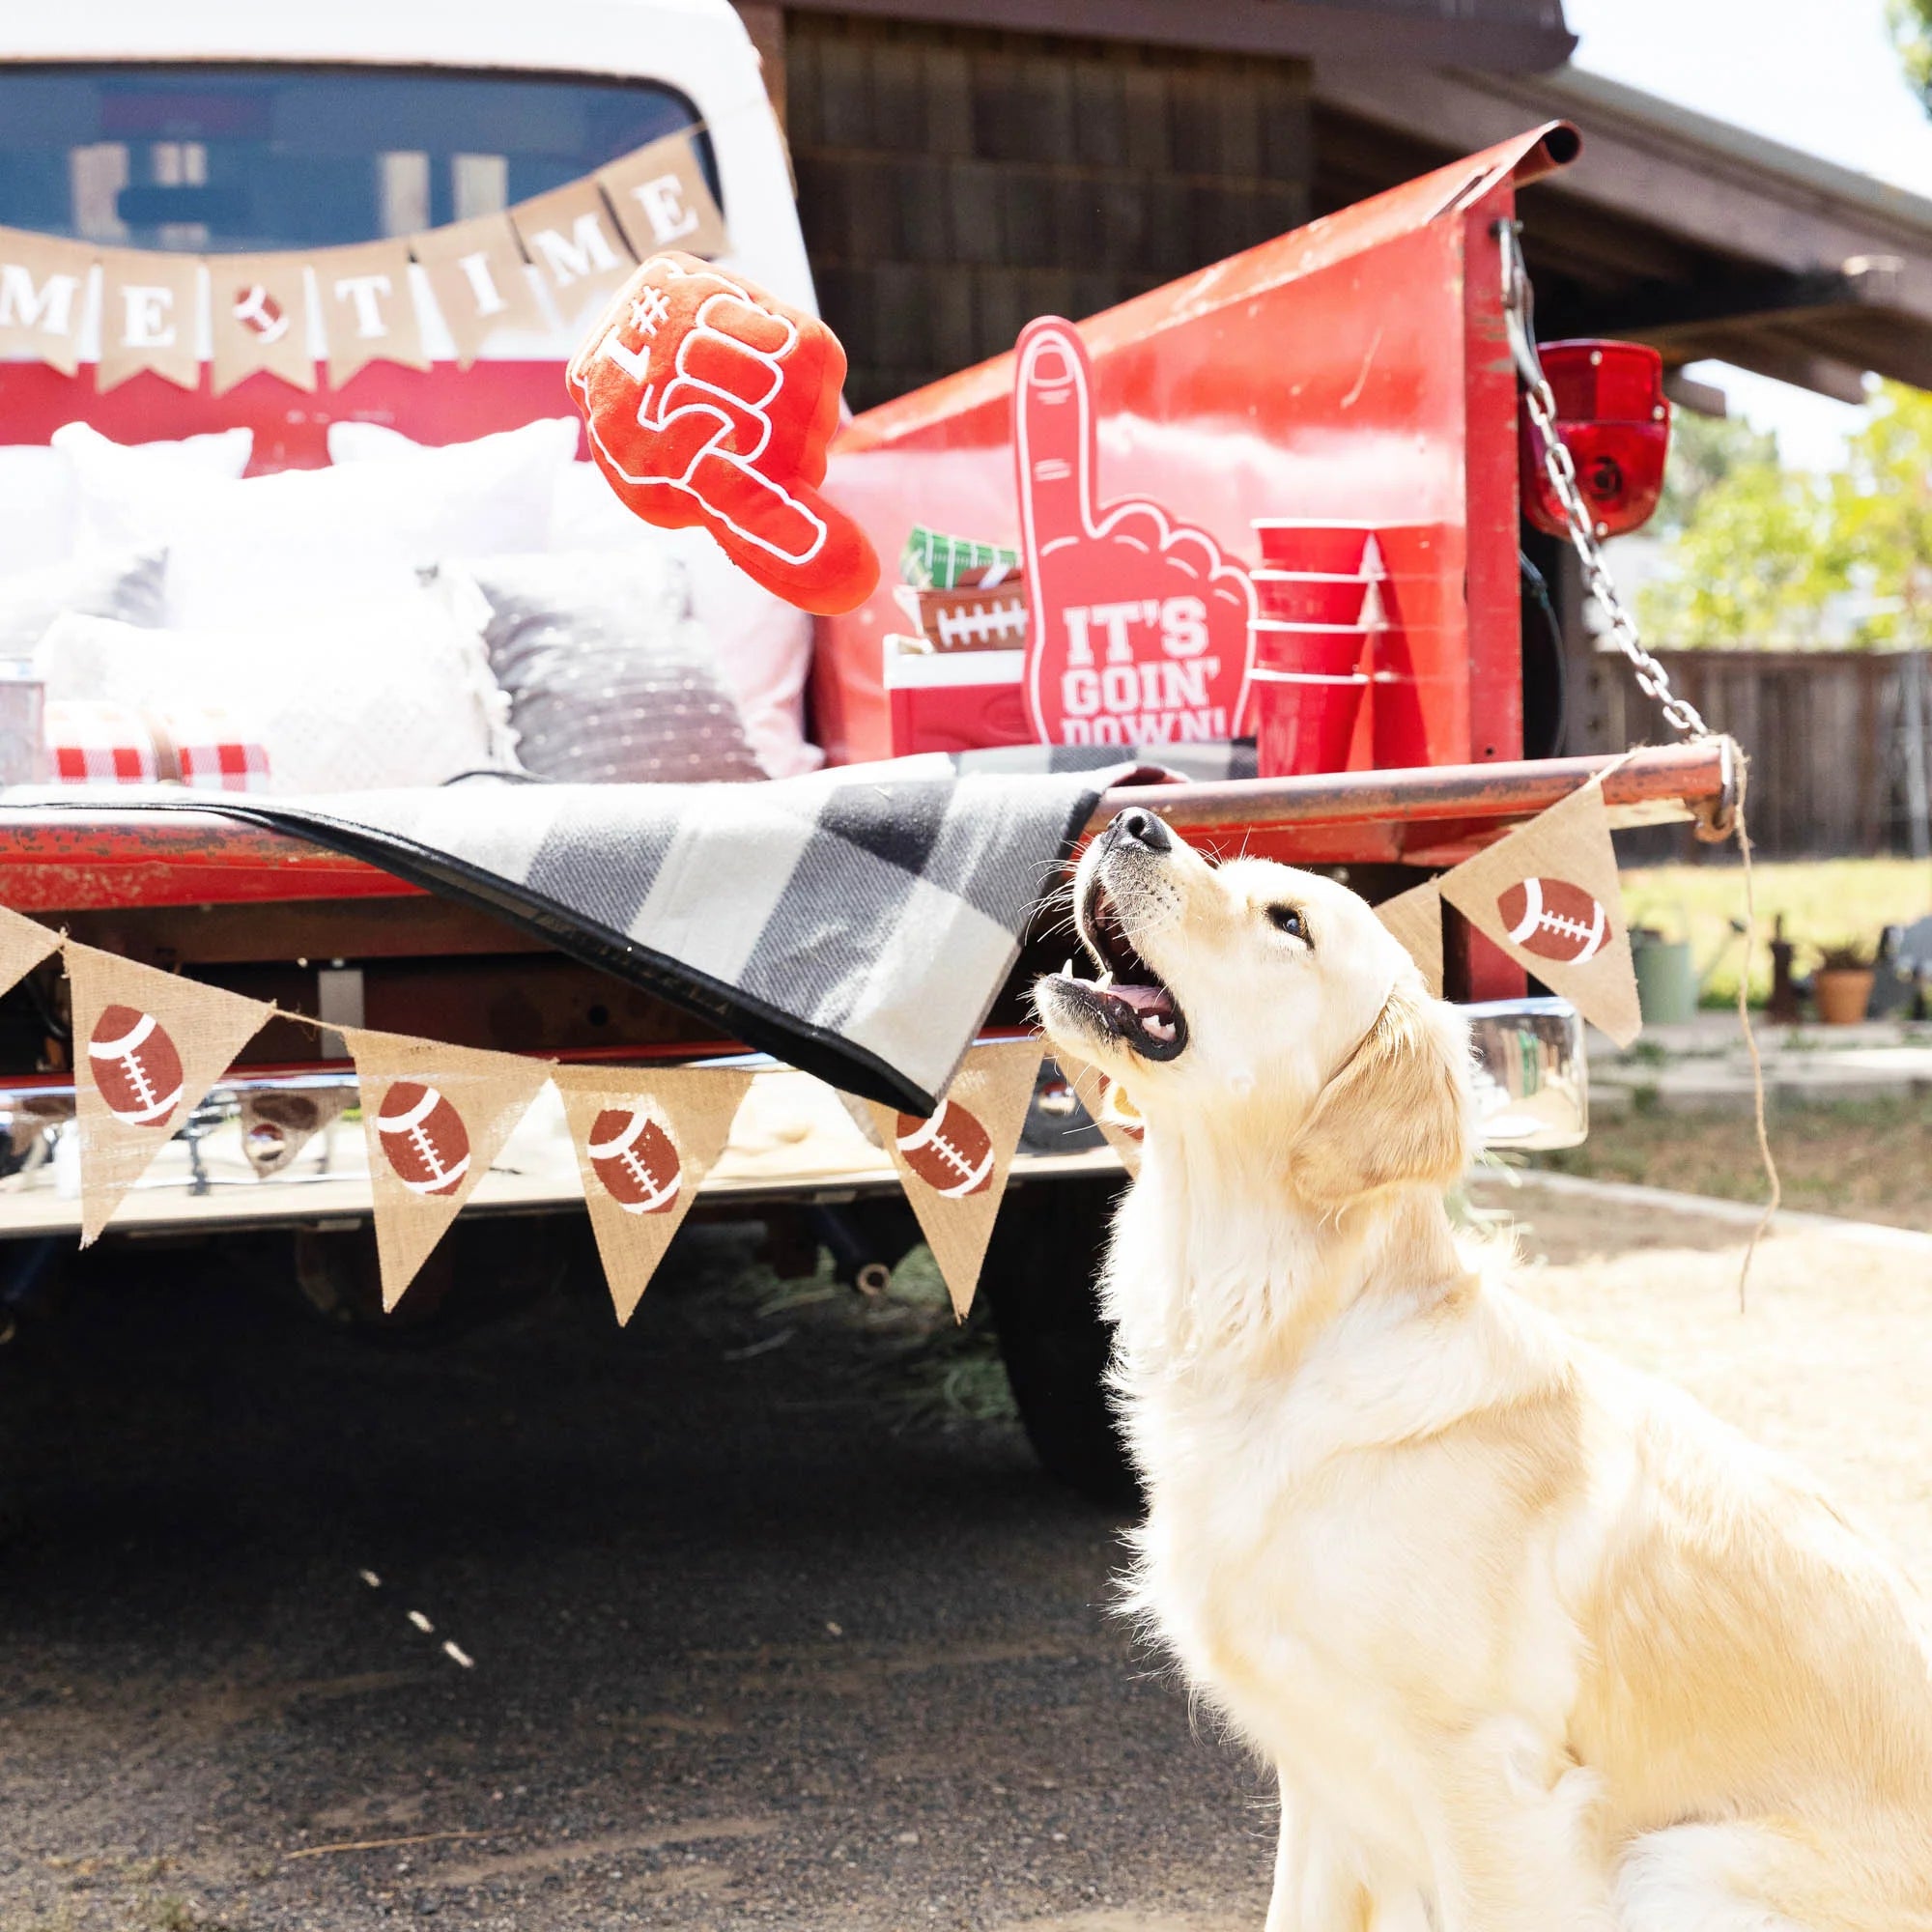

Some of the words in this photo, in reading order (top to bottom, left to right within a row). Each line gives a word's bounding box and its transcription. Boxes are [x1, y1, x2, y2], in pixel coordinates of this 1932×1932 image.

[334, 174, 699, 337] TIME
[1063, 596, 1208, 665] IT'S
[1062, 656, 1220, 716] GOIN'
